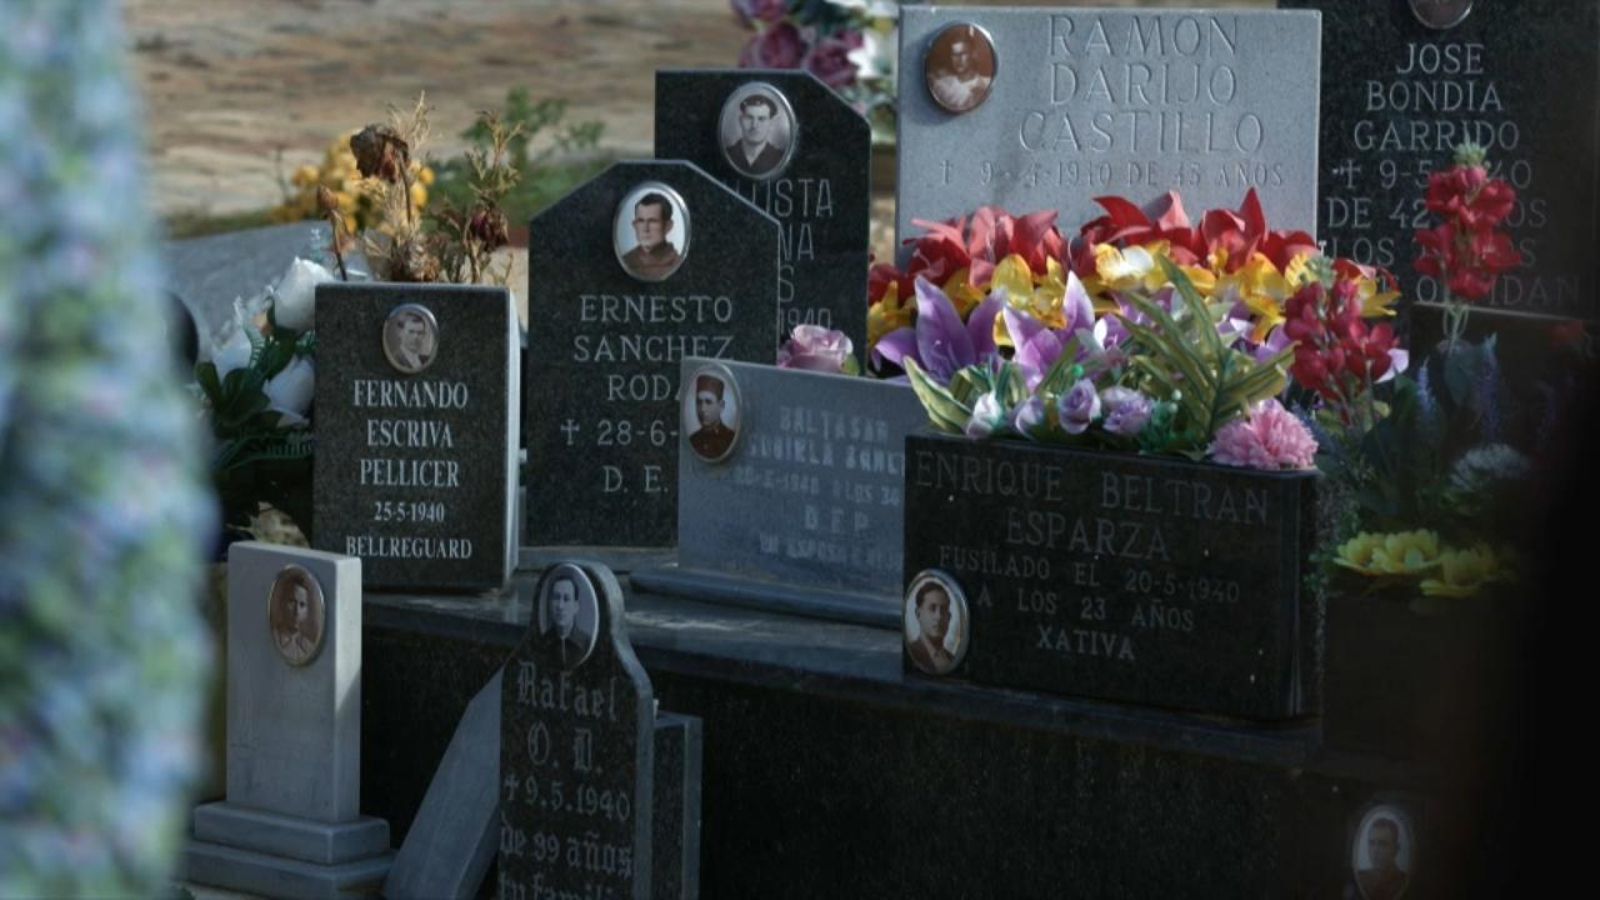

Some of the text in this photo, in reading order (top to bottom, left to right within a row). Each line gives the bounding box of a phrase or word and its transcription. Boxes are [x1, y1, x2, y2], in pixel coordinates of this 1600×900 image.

[1048, 15, 1240, 57] RAMON
[1396, 42, 1486, 75] JOSE
[1050, 63, 1237, 106] DARIJO
[1365, 80, 1504, 112] BONDIA
[1019, 111, 1264, 153] CASTILLO
[1353, 119, 1520, 152] GARRIDO
[1127, 160, 1157, 188] DE
[1327, 197, 1373, 229] DE
[1389, 197, 1431, 229] 42
[579, 294, 733, 324] ERNESTO
[573, 333, 735, 363] SANCHEZ
[353, 378, 469, 410] FERNANDO
[607, 373, 681, 402] ROD
[367, 418, 454, 448] ESCRIVA
[360, 458, 460, 488] PELLICER
[915, 450, 1271, 525] ENRIQUE BELTRAN
[345, 534, 474, 561] BELLREGUARD
[1006, 506, 1172, 562] ESPARZA
[938, 544, 1050, 580] FUSILADO
[1073, 561, 1100, 588] EL
[976, 582, 1195, 633] A LOS 23 AÑOS
[1036, 625, 1136, 661] XATIVA
[516, 658, 619, 722] Rafael
[500, 810, 527, 860] de
[565, 829, 634, 880] años
